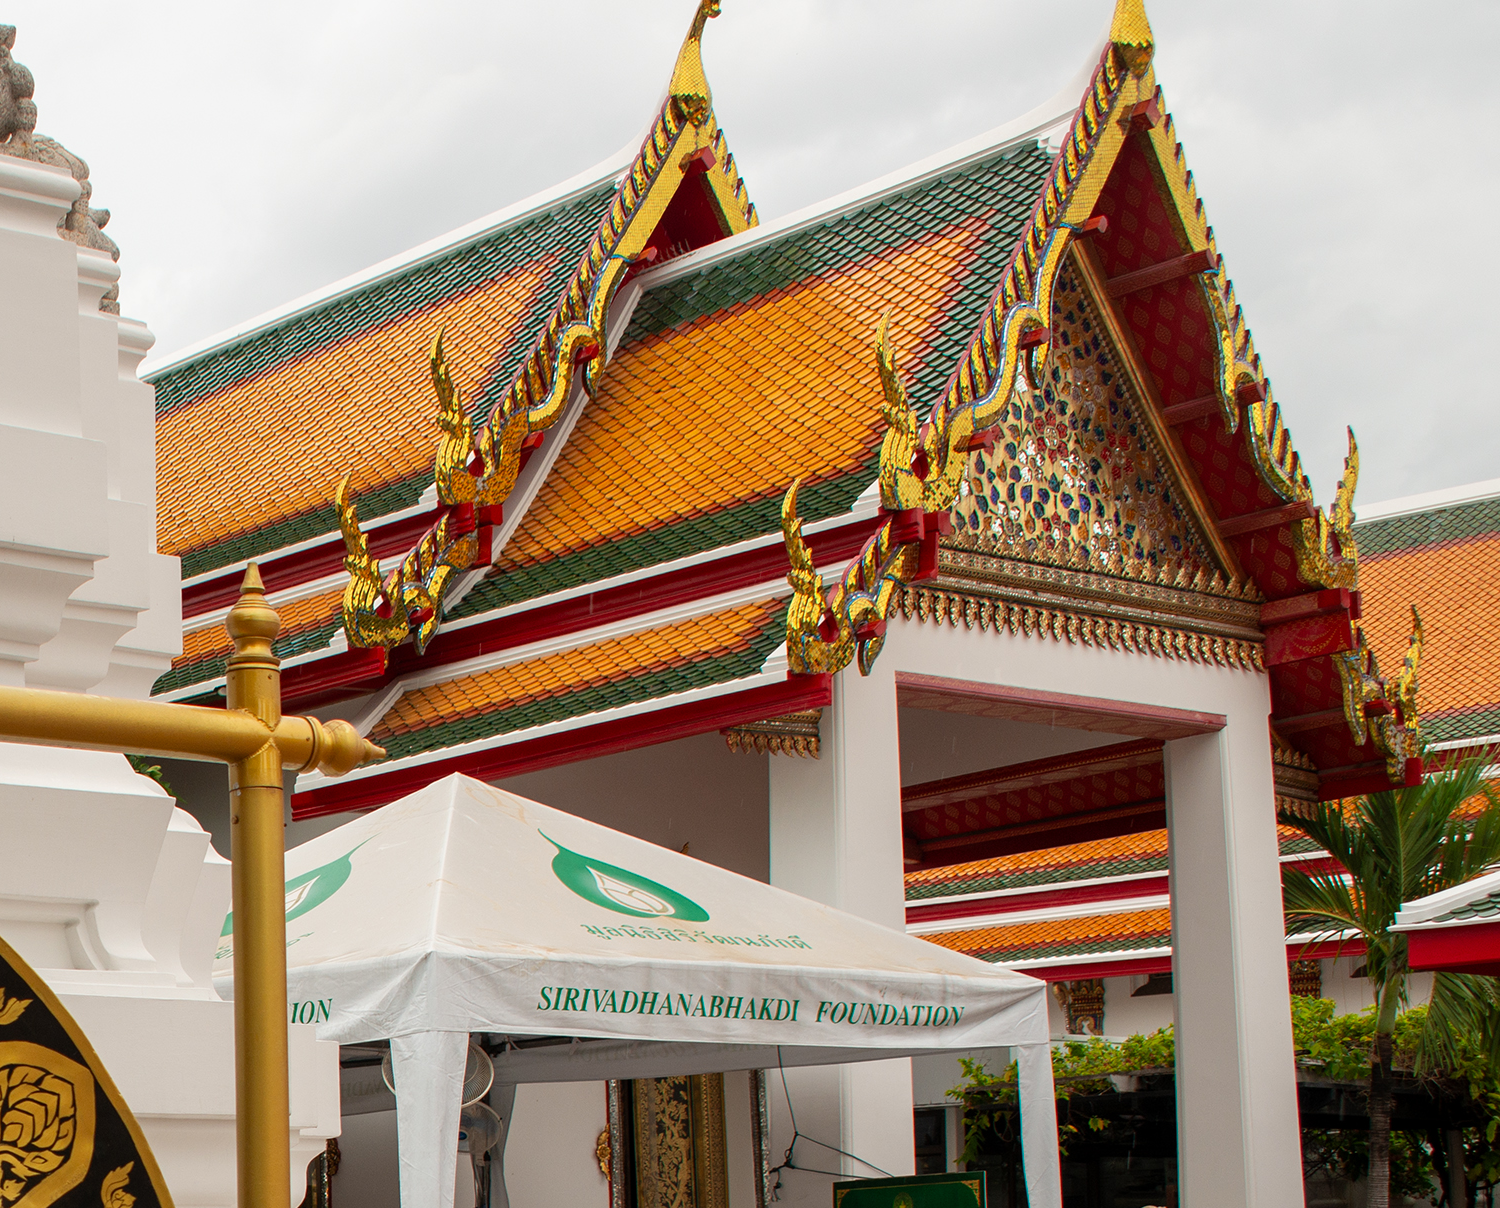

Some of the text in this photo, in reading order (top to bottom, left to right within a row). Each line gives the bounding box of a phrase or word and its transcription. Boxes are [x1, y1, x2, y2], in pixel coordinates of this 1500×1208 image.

[580, 924, 813, 950] มูลนิธิสิริวัฒนภักดี
[536, 986, 966, 1028] SIRIVADHANABHAKDI FOUNDATION
